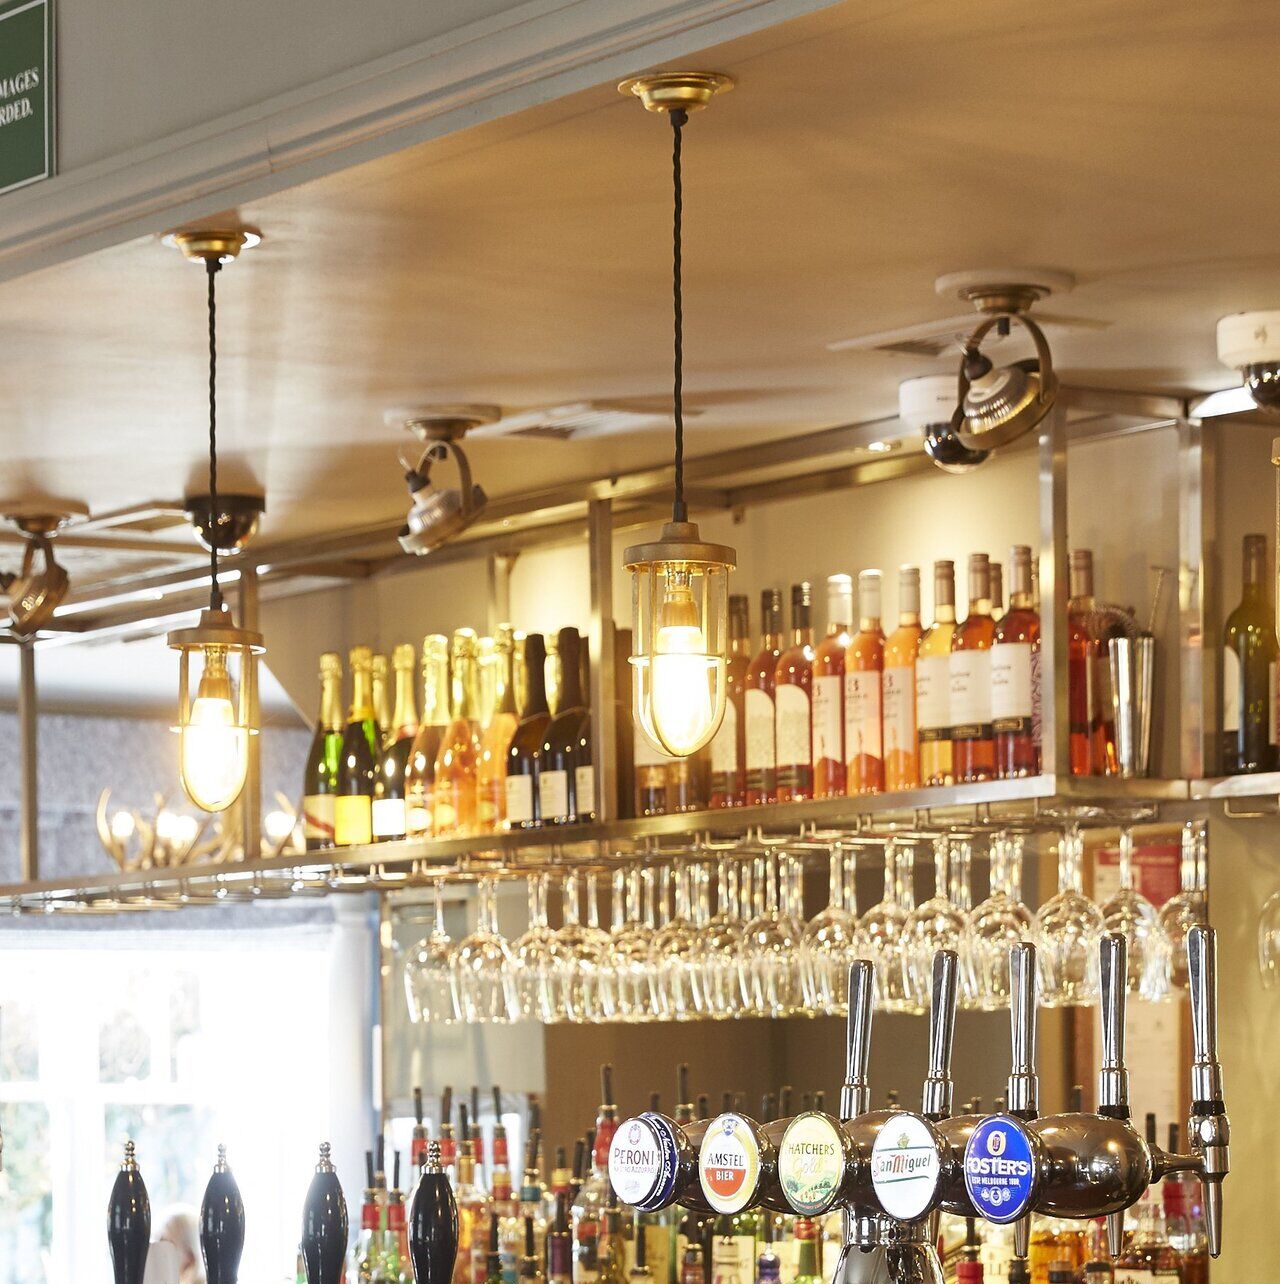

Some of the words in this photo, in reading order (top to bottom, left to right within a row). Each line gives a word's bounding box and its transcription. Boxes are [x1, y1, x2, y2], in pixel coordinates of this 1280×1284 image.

[614, 1147, 655, 1165] PERONI
[788, 1142, 835, 1155] HATCHERS
[707, 1153, 744, 1167] AMSTEL
[873, 1156, 892, 1177] San
[891, 1154, 931, 1174] Miguel
[968, 1156, 1030, 1176] FOSTER'S
[715, 1170, 734, 1181] BIER
